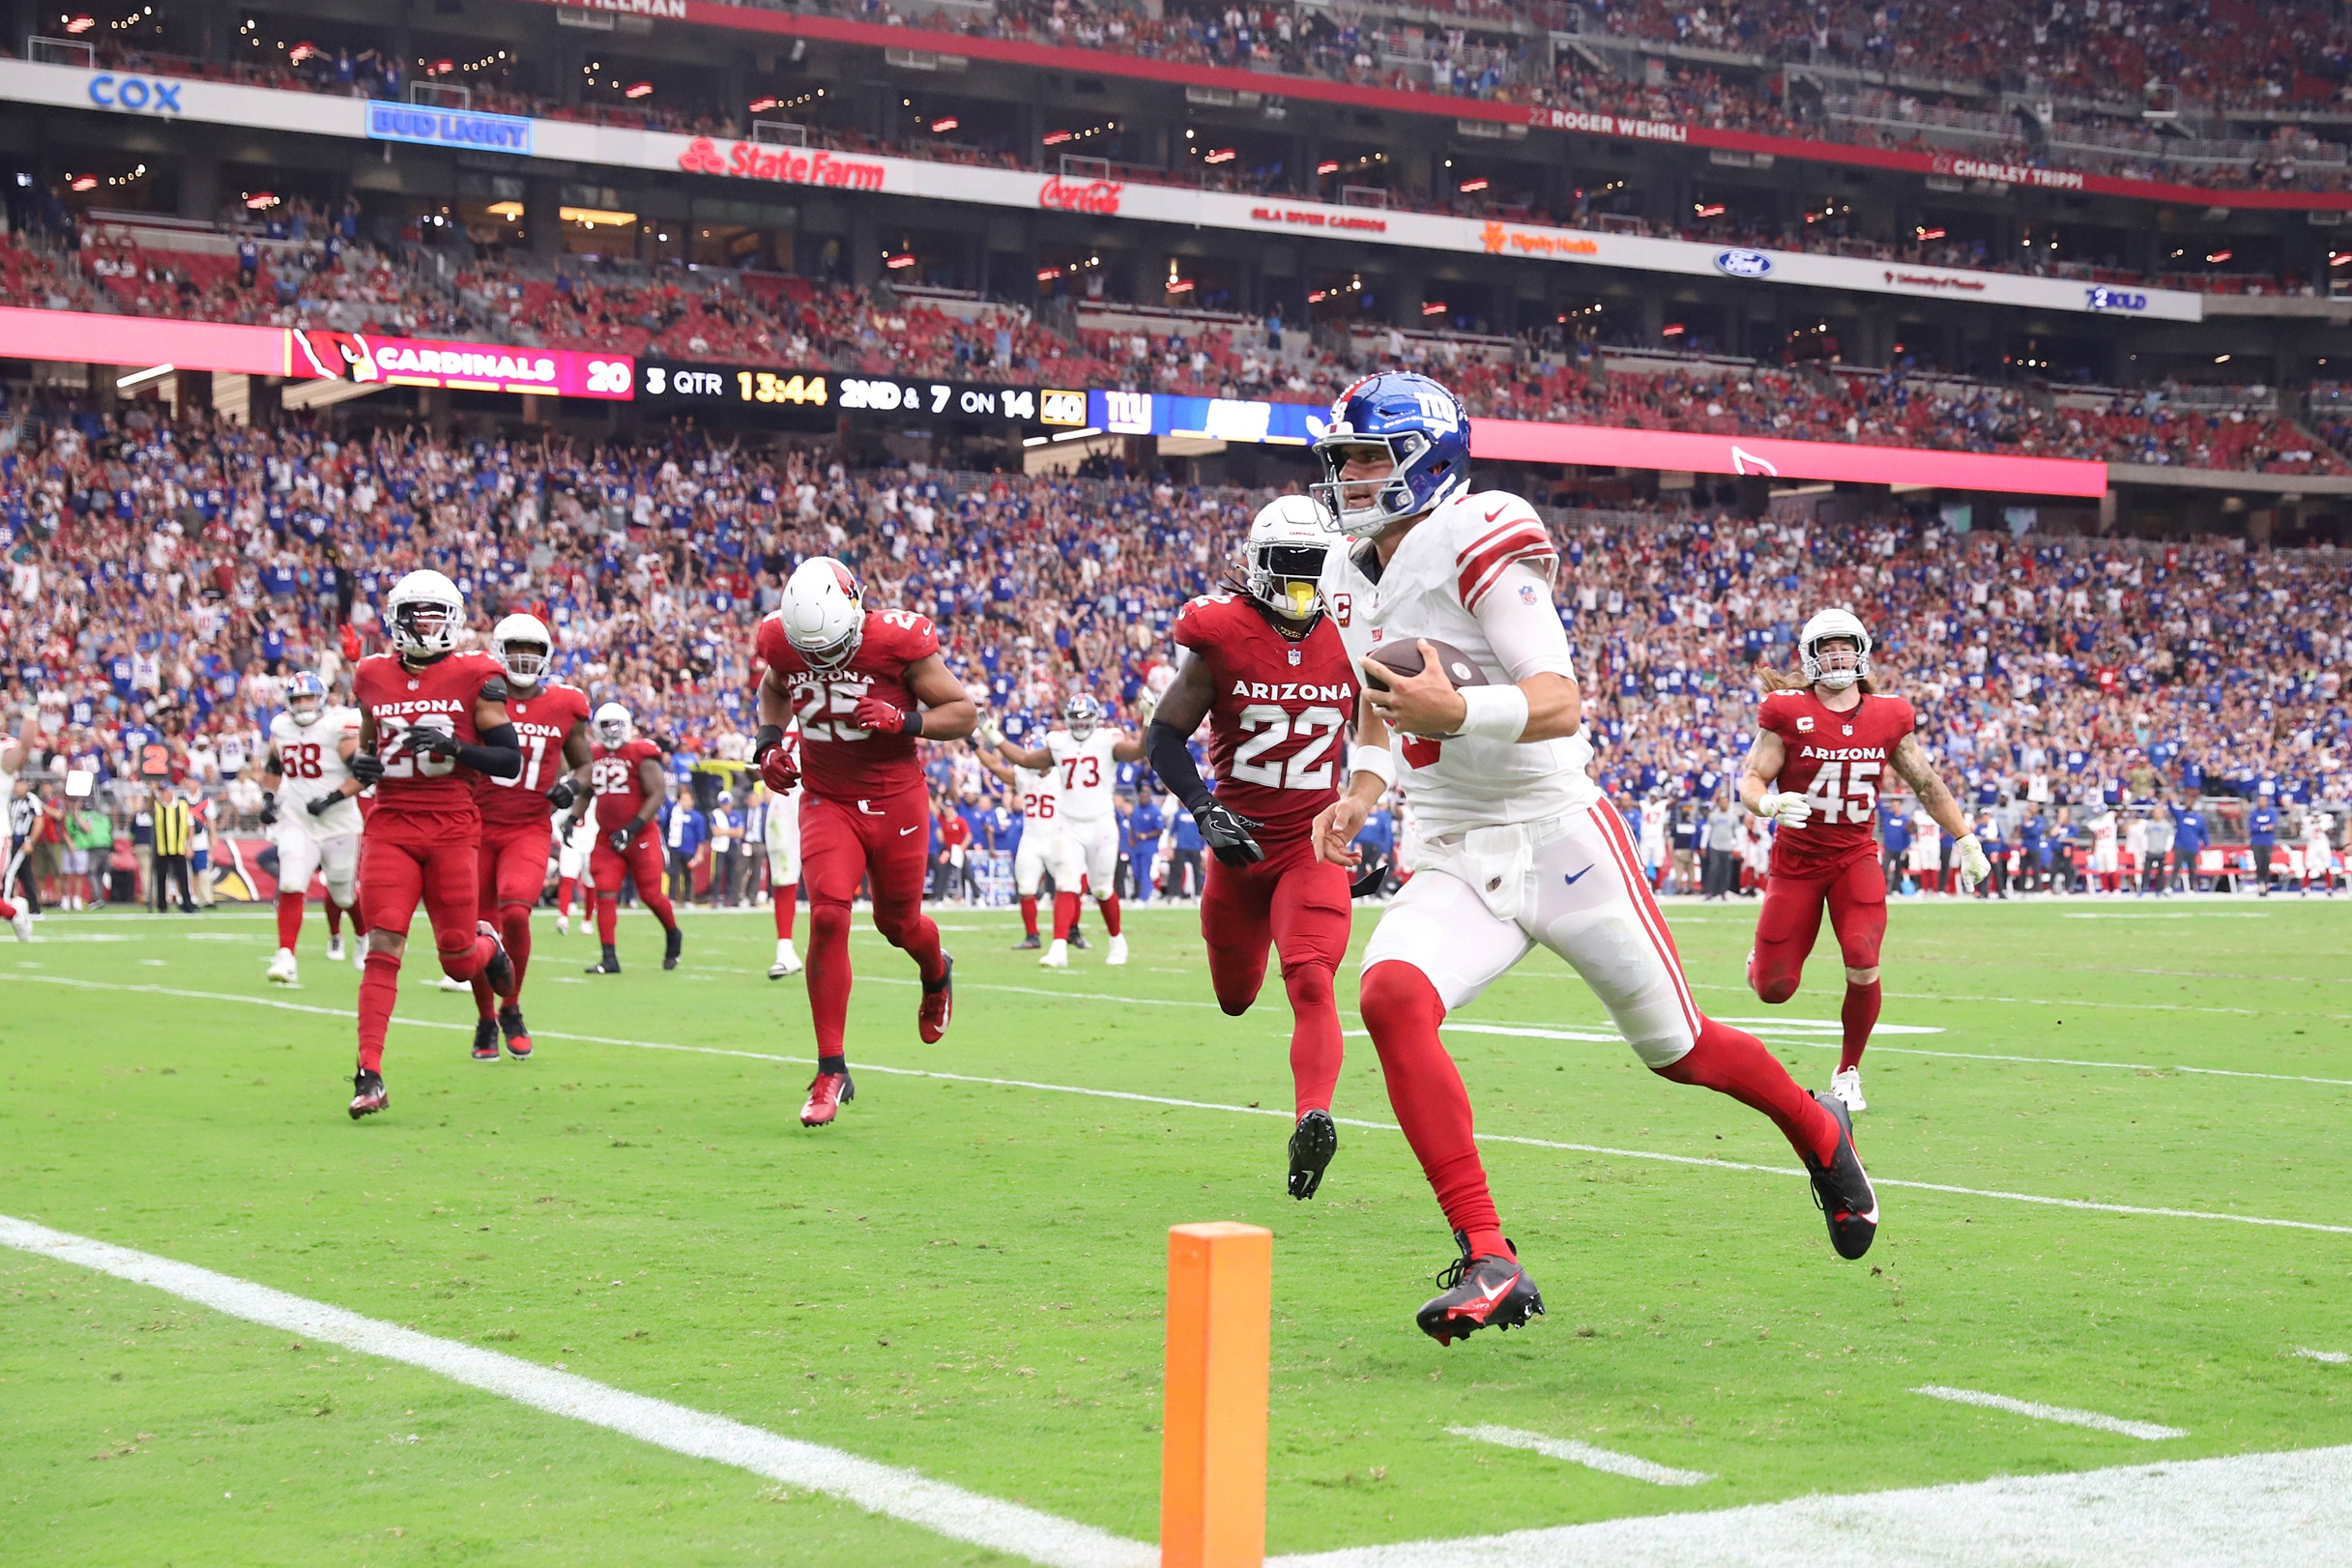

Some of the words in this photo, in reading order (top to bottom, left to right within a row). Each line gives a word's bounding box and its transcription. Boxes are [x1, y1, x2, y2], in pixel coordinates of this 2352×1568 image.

[90, 75, 180, 111] COX
[373, 109, 437, 137] BUD
[441, 115, 525, 147] LIGHT
[1551, 110, 1614, 134] ROGER
[1617, 117, 1687, 143] WEHRLI
[1953, 160, 2029, 184] CHARLEY
[2031, 167, 2083, 190] TRIPPI
[1726, 250, 1763, 275] Ford
[375, 346, 556, 382] CARDINALS
[587, 361, 631, 393] 20
[646, 367, 666, 394] 3
[673, 371, 723, 395] QTR
[737, 370, 828, 406] 13:44
[839, 378, 902, 410] 2ND
[902, 387, 920, 409] &
[930, 385, 951, 413] 7
[960, 391, 995, 415] ON
[1001, 390, 1034, 420] 14
[1043, 394, 1084, 423] 40
[787, 670, 875, 685] ARIZONA
[1232, 680, 1352, 702] ARIZONA
[371, 699, 465, 717] ARIZONA
[1796, 716, 1815, 730] C
[512, 722, 562, 739] ZONA
[142, 744, 169, 774] 2
[1230, 704, 1345, 790] 22
[1800, 745, 1886, 760] ARIZONA
[592, 765, 630, 796] 92
[1061, 756, 1100, 790] 73
[1025, 794, 1056, 819] 26
[1807, 762, 1881, 824] 45
